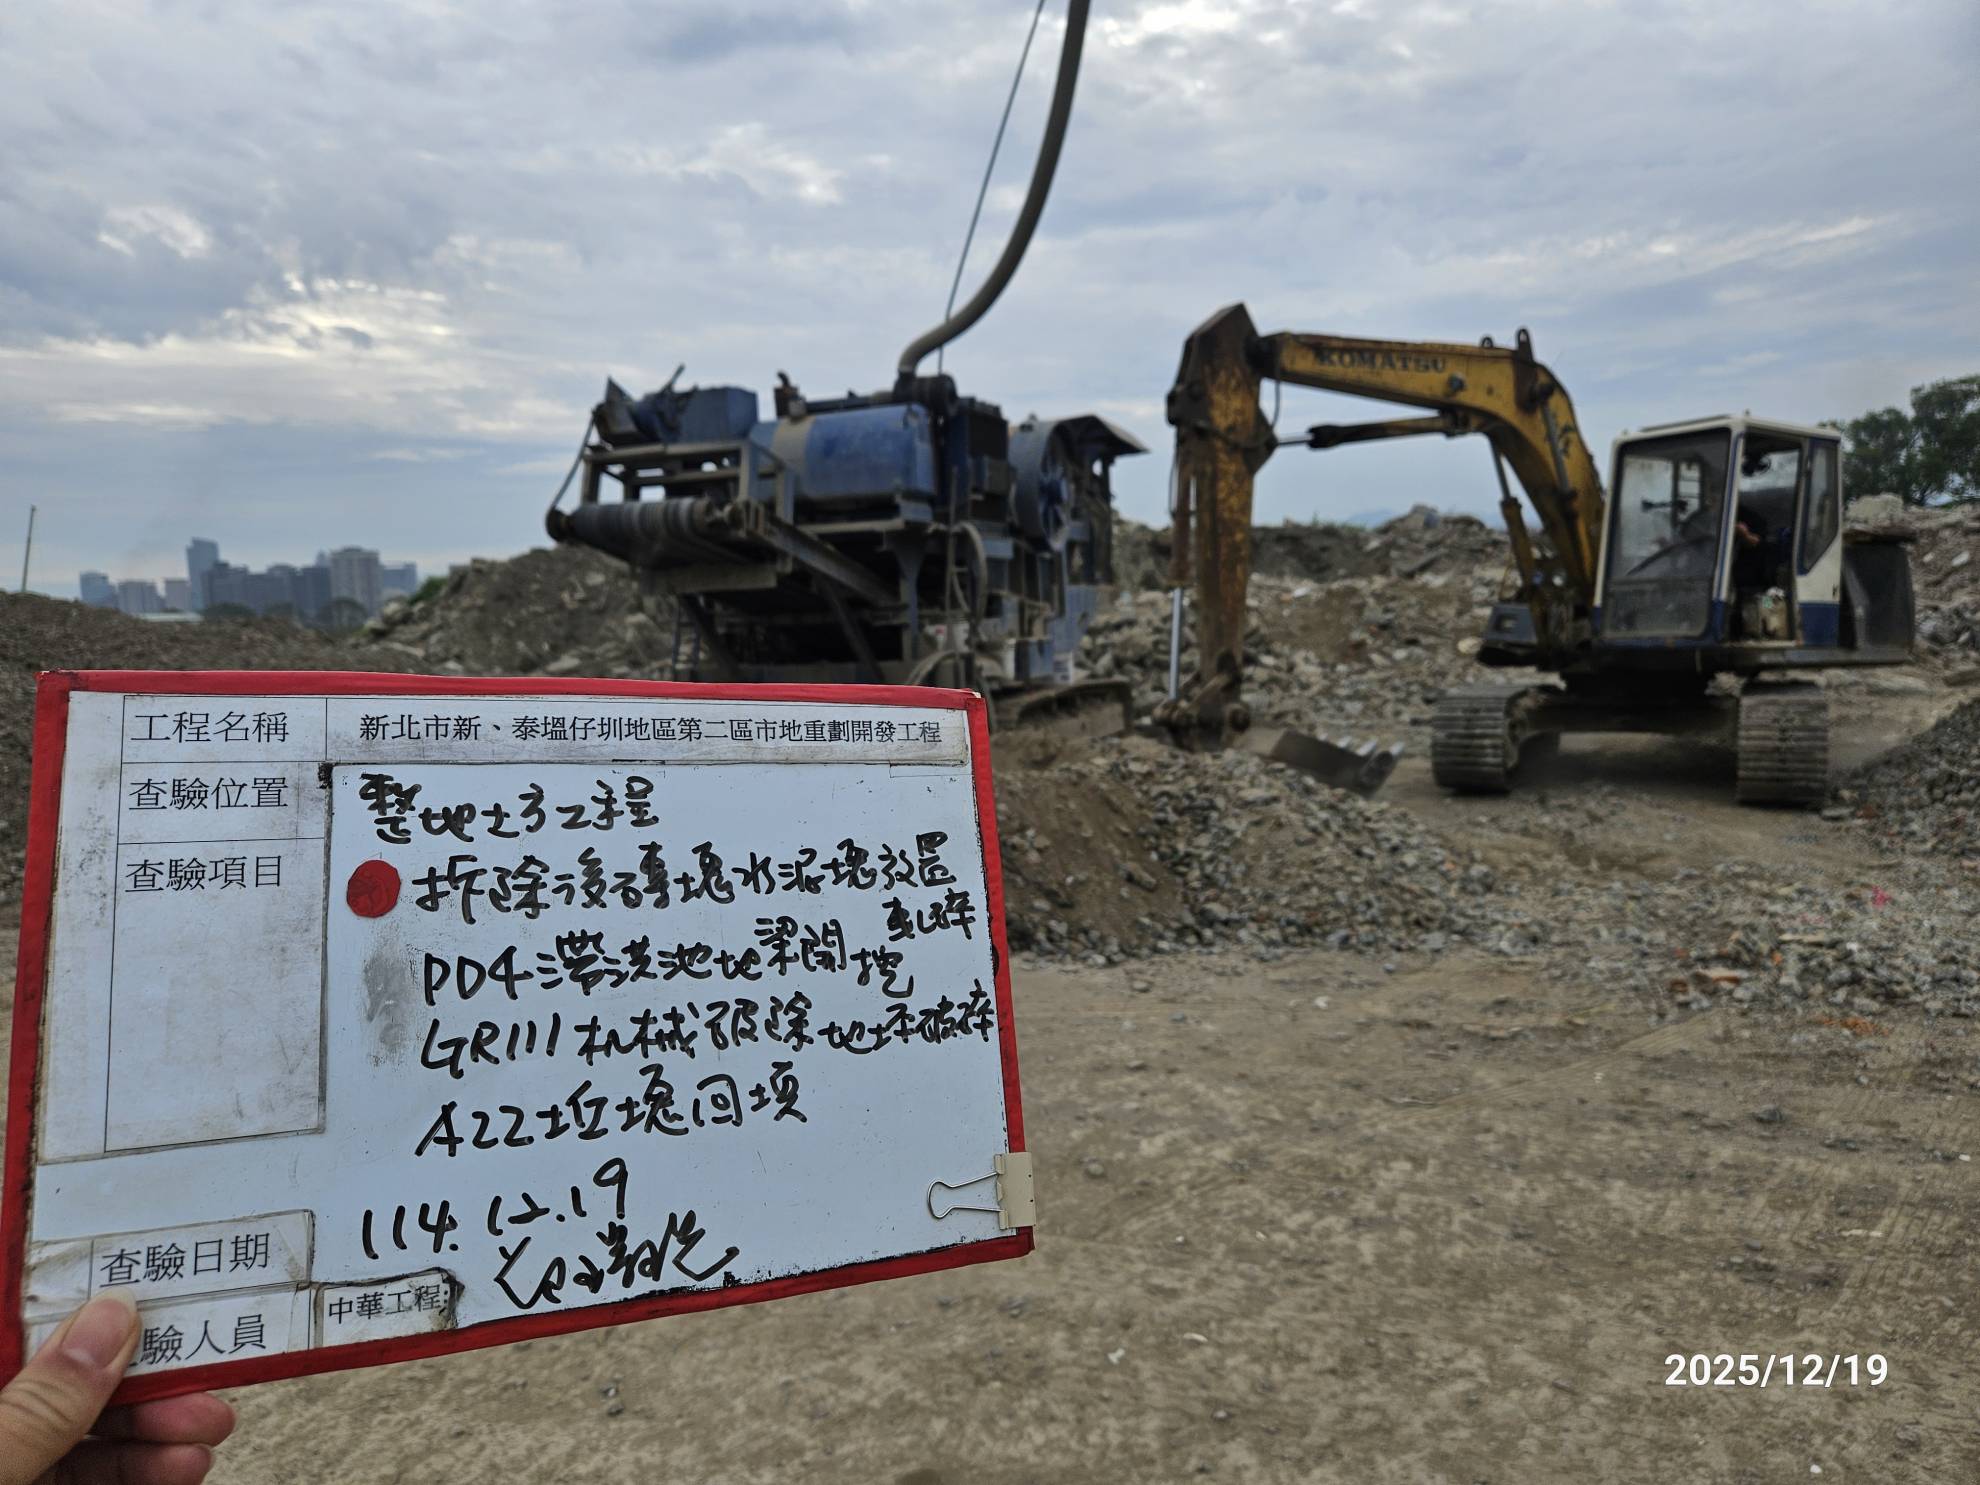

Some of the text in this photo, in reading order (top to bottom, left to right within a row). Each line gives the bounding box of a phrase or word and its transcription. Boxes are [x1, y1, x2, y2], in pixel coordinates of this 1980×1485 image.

[1313, 348, 1447, 373] KOMATSU
[131, 711, 290, 743] 工程名稱
[360, 714, 942, 744] 新北市新、泰塭仔圳地區第二區市地重劃開發工程
[128, 776, 289, 811] 查驗位置
[124, 855, 283, 893] 查驗項目
[100, 1232, 271, 1289] 查驗日期
[328, 1284, 442, 1325] 中華工程
[128, 1313, 267, 1369] 驗人員
